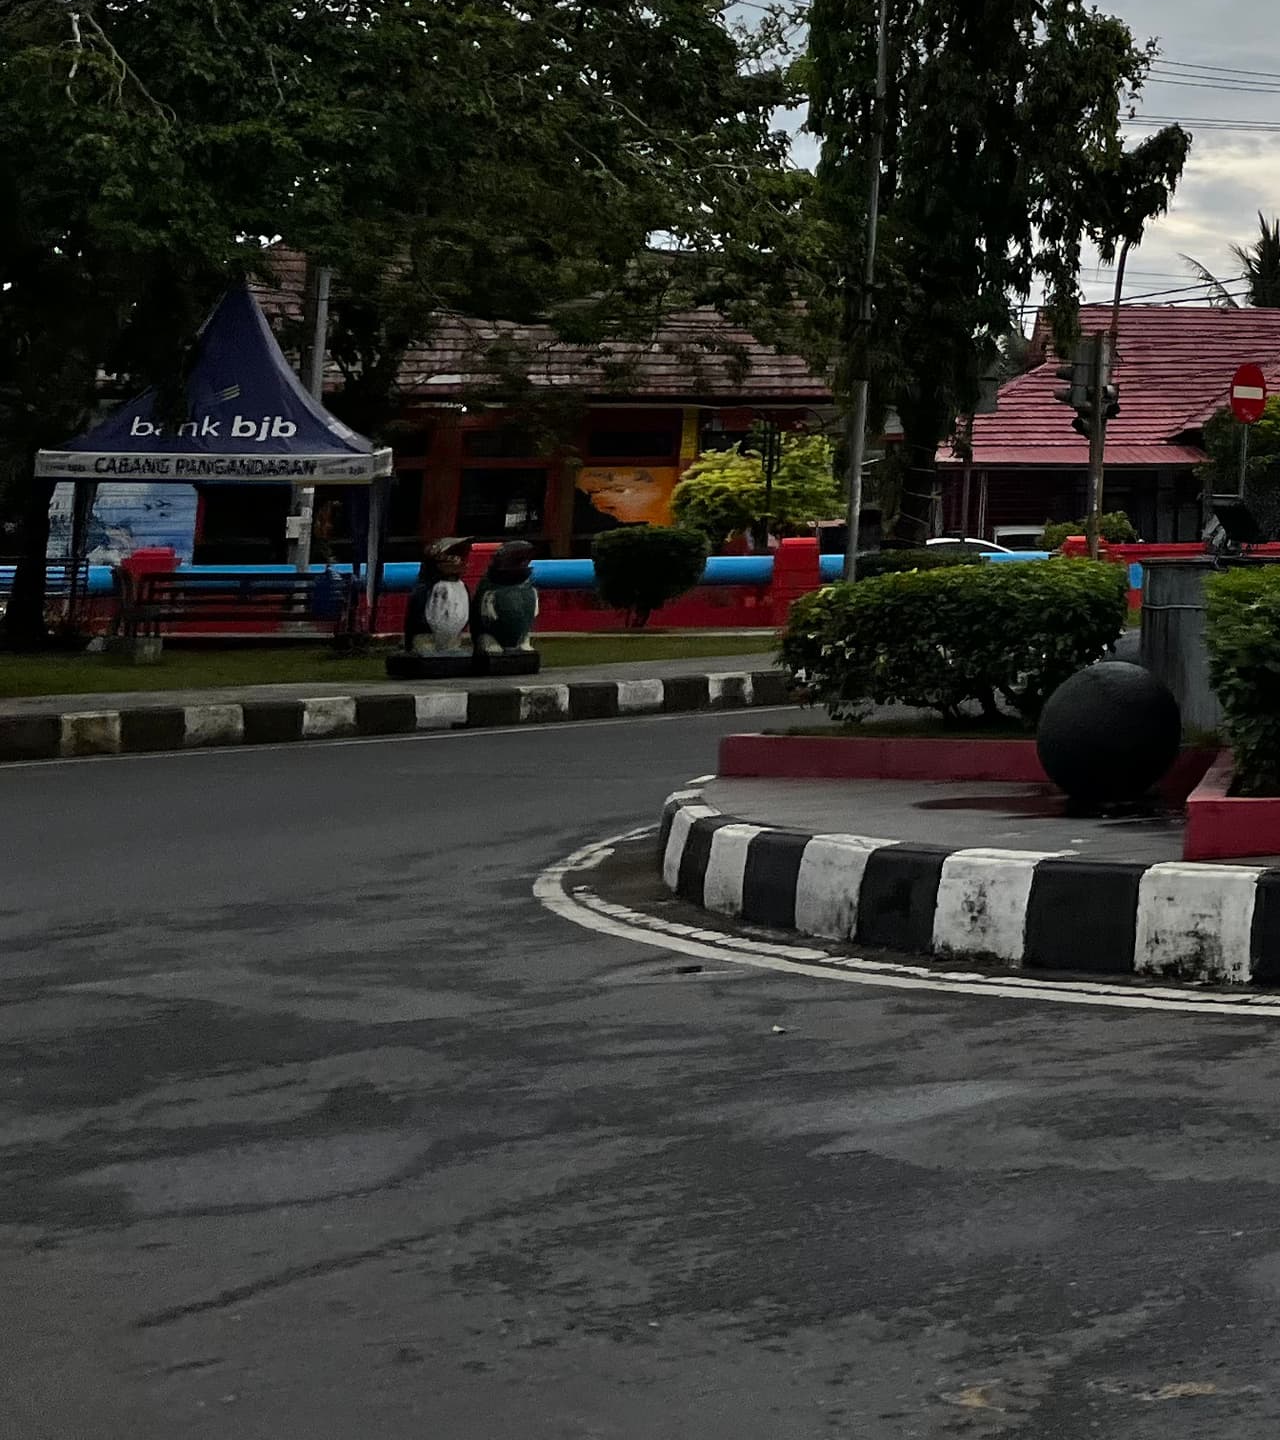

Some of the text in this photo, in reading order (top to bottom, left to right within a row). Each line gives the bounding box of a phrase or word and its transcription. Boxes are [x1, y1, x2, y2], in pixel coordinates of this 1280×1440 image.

[130, 415, 297, 442] bnk bjb
[94, 457, 170, 475] CABANG
